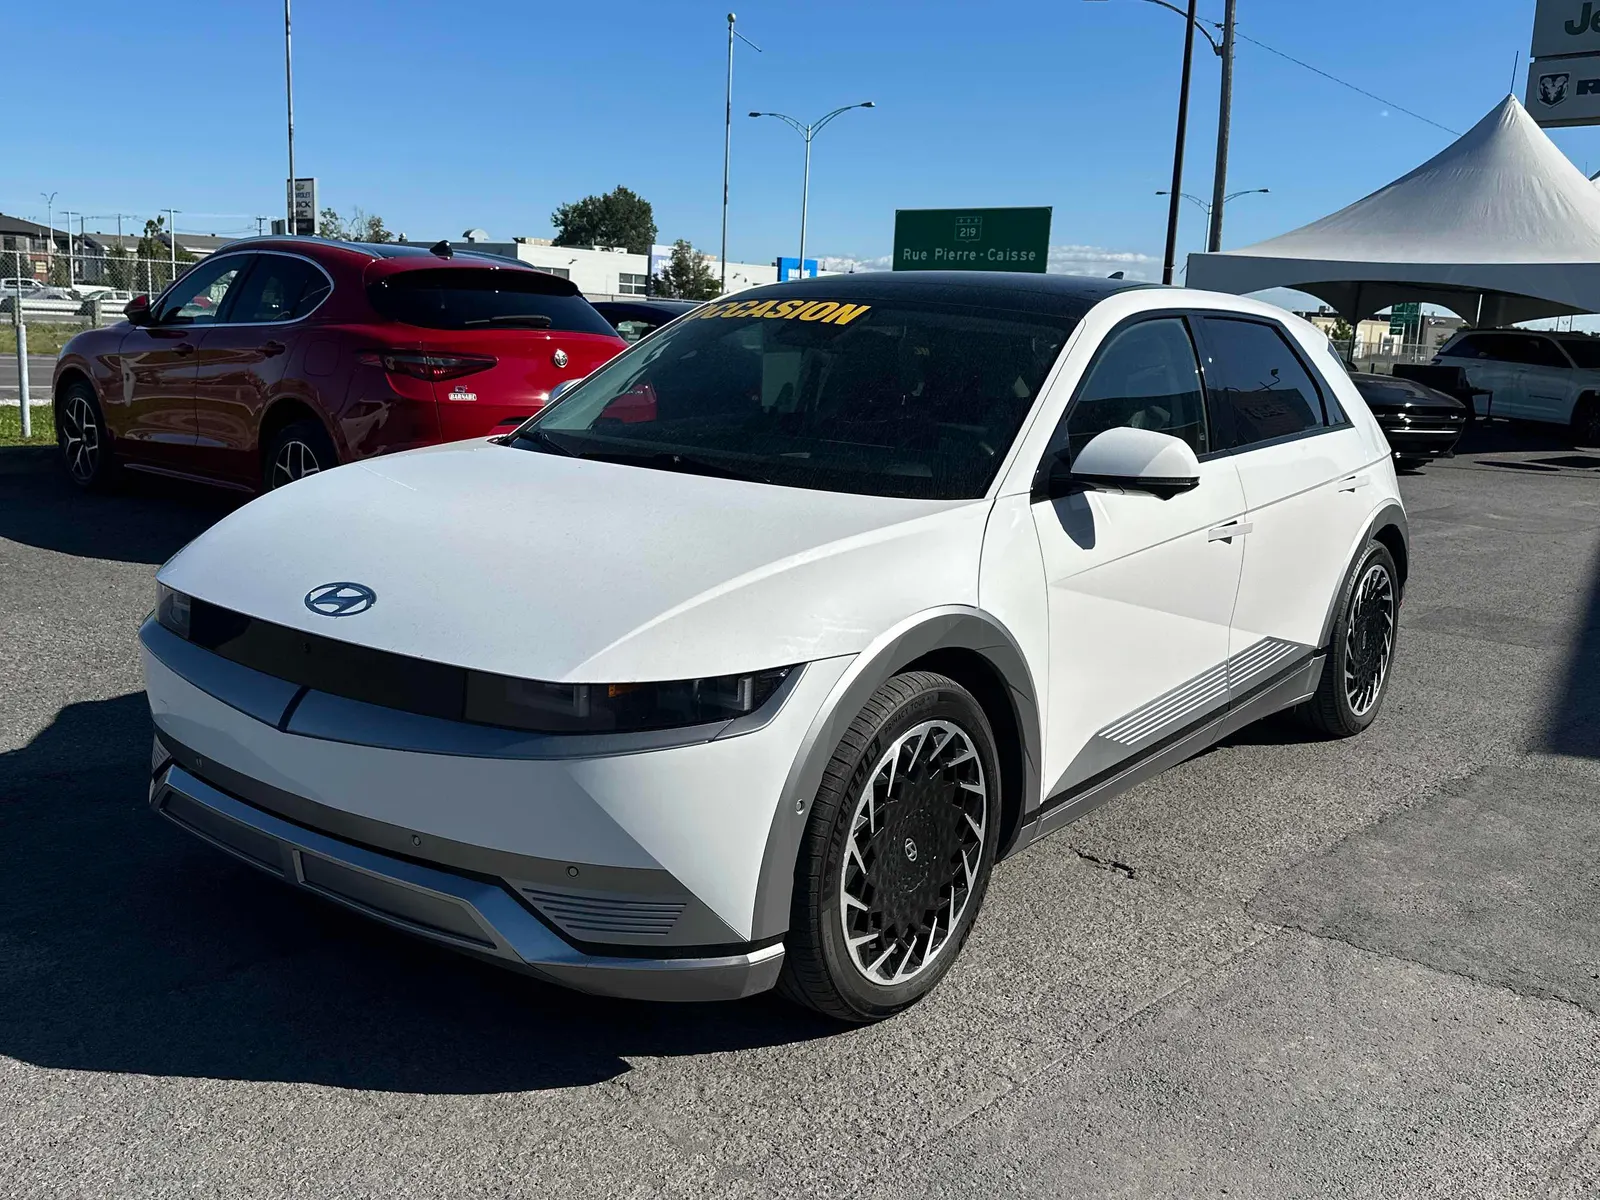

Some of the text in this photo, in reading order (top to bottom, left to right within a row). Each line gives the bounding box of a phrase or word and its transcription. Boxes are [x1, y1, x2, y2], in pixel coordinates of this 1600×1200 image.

[959, 227, 977, 237] 219
[903, 248, 928, 260] Rue
[884, 706, 909, 734] PRIMACY
[828, 737, 882, 865] MICHELIN
